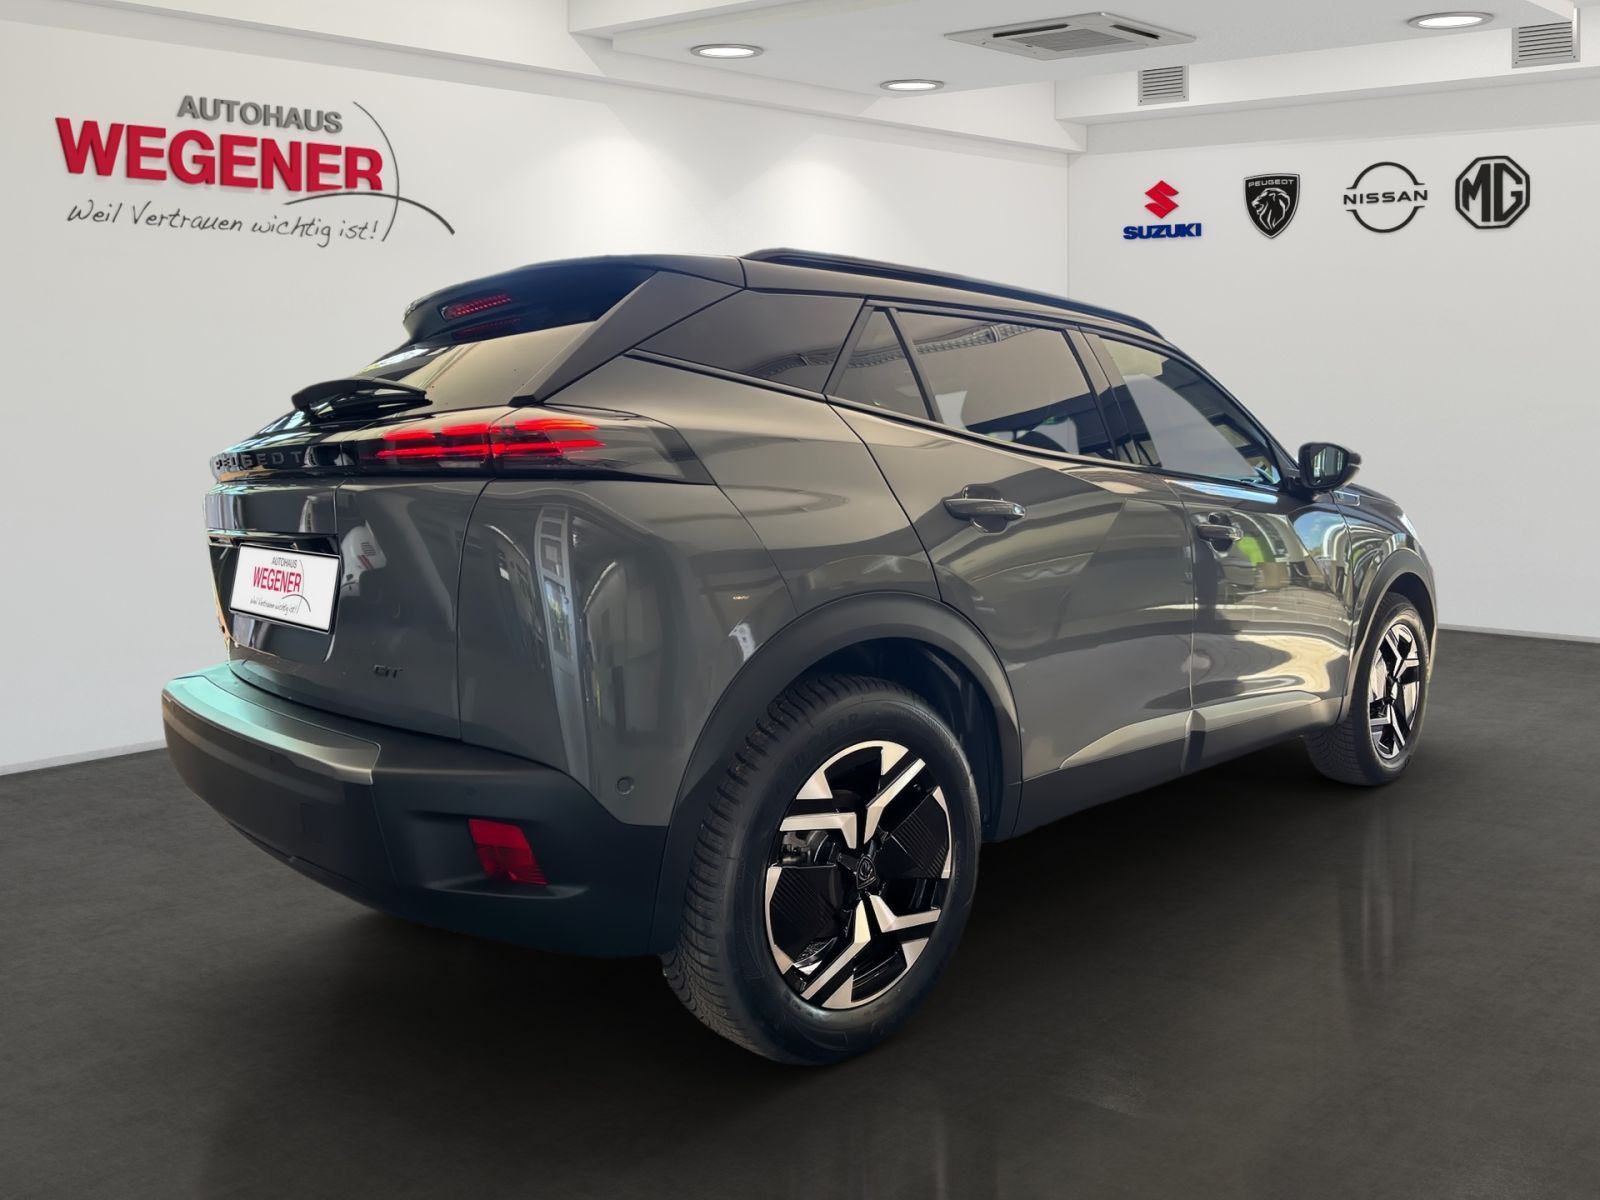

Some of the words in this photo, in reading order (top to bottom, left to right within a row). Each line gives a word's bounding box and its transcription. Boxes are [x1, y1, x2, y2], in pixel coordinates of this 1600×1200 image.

[177, 95, 343, 134] AUTOHAUS
[55, 117, 384, 192] WEGENER
[1247, 178, 1295, 188] PEUGEOT
[1462, 163, 1524, 223] MG
[1343, 189, 1429, 205] NISSAN
[67, 199, 122, 223] Weil
[132, 200, 243, 232] Vertrauen
[251, 215, 331, 248] wichtig
[339, 219, 378, 240] ist!
[1123, 222, 1202, 240] SUZUKI
[272, 557, 298, 568] AUTOHAUS
[253, 566, 302, 593] WEGENER
